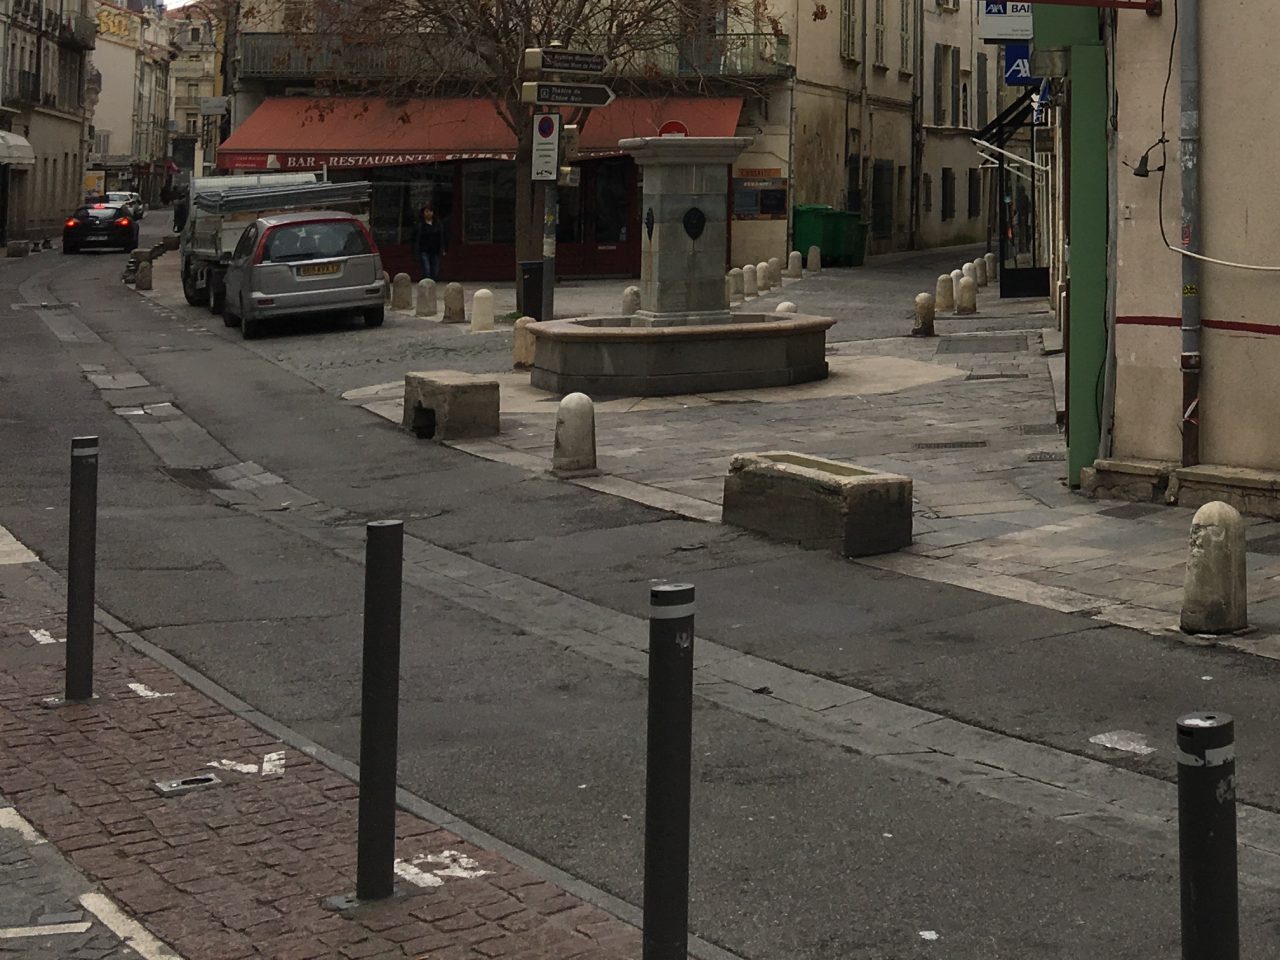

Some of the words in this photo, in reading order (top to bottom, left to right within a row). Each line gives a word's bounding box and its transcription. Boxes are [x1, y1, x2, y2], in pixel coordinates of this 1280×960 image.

[986, 4, 1004, 13] AXA
[1005, 58, 1030, 78] AX
[287, 155, 316, 168] BAR
